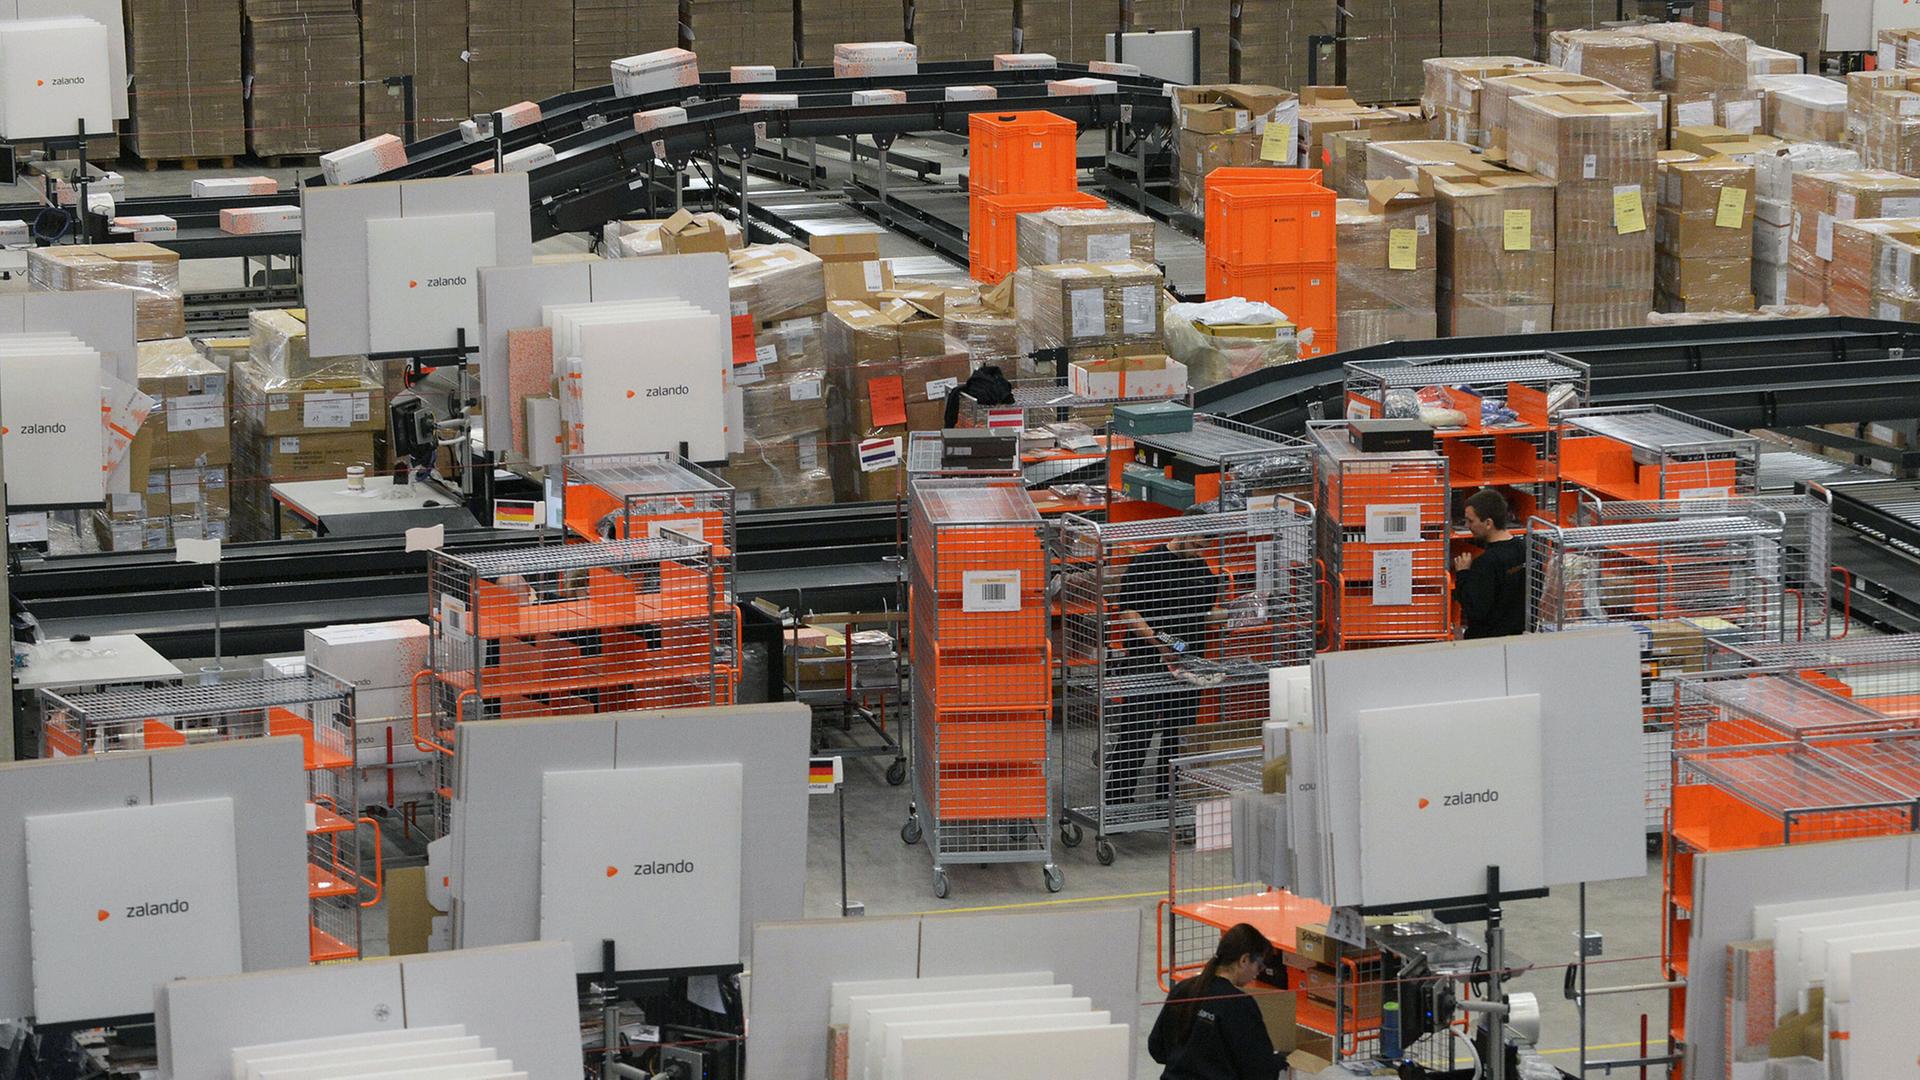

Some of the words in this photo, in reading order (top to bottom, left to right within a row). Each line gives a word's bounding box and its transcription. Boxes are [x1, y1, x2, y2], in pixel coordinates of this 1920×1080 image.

[52, 76, 85, 86] zalando
[427, 275, 467, 288] zalando
[646, 384, 690, 398] zalando
[20, 422, 67, 435] zalando
[1444, 788, 1499, 807] zalando
[634, 859, 695, 876] zalando
[126, 898, 190, 919] zalando
